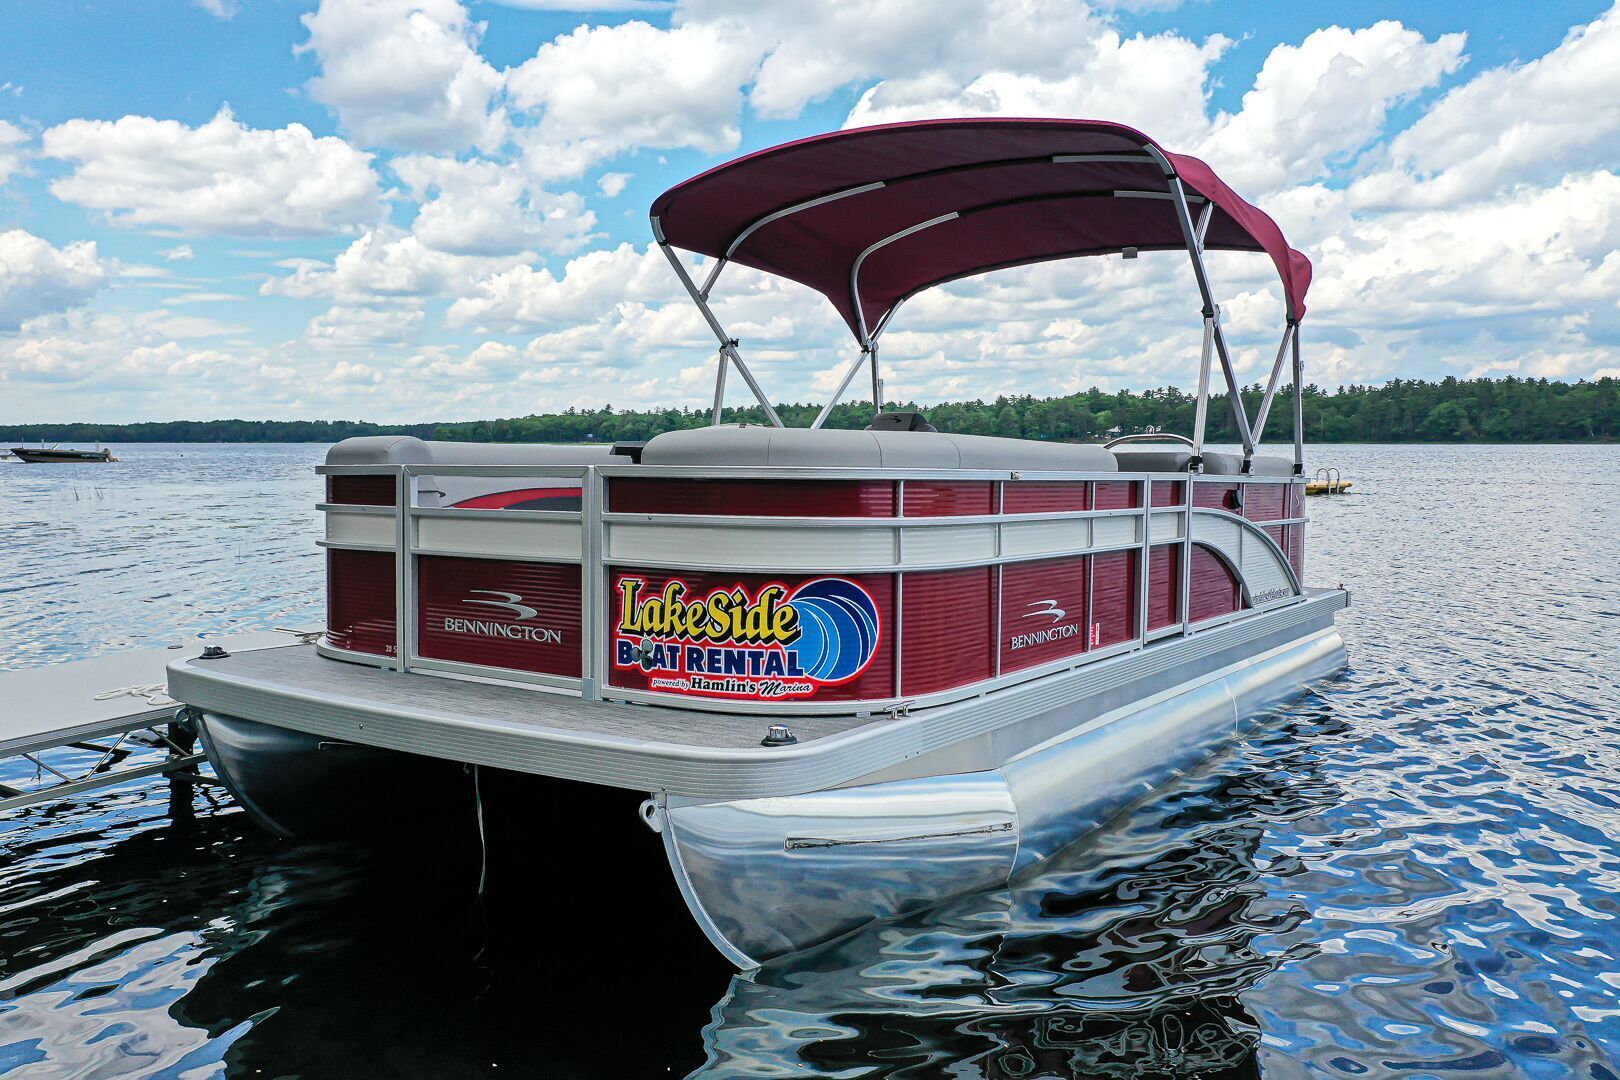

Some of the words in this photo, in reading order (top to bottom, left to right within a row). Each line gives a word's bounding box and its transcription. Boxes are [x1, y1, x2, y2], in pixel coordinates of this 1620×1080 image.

[620, 579, 801, 645] LakeSide
[444, 618, 562, 644] BENNINGTON
[1011, 624, 1078, 650] BENNINGTON
[687, 647, 803, 676] RENTAL
[652, 678, 680, 687] powered
[680, 680, 689, 689] by
[691, 677, 756, 693] Hamlin's
[759, 681, 811, 696] Marina
